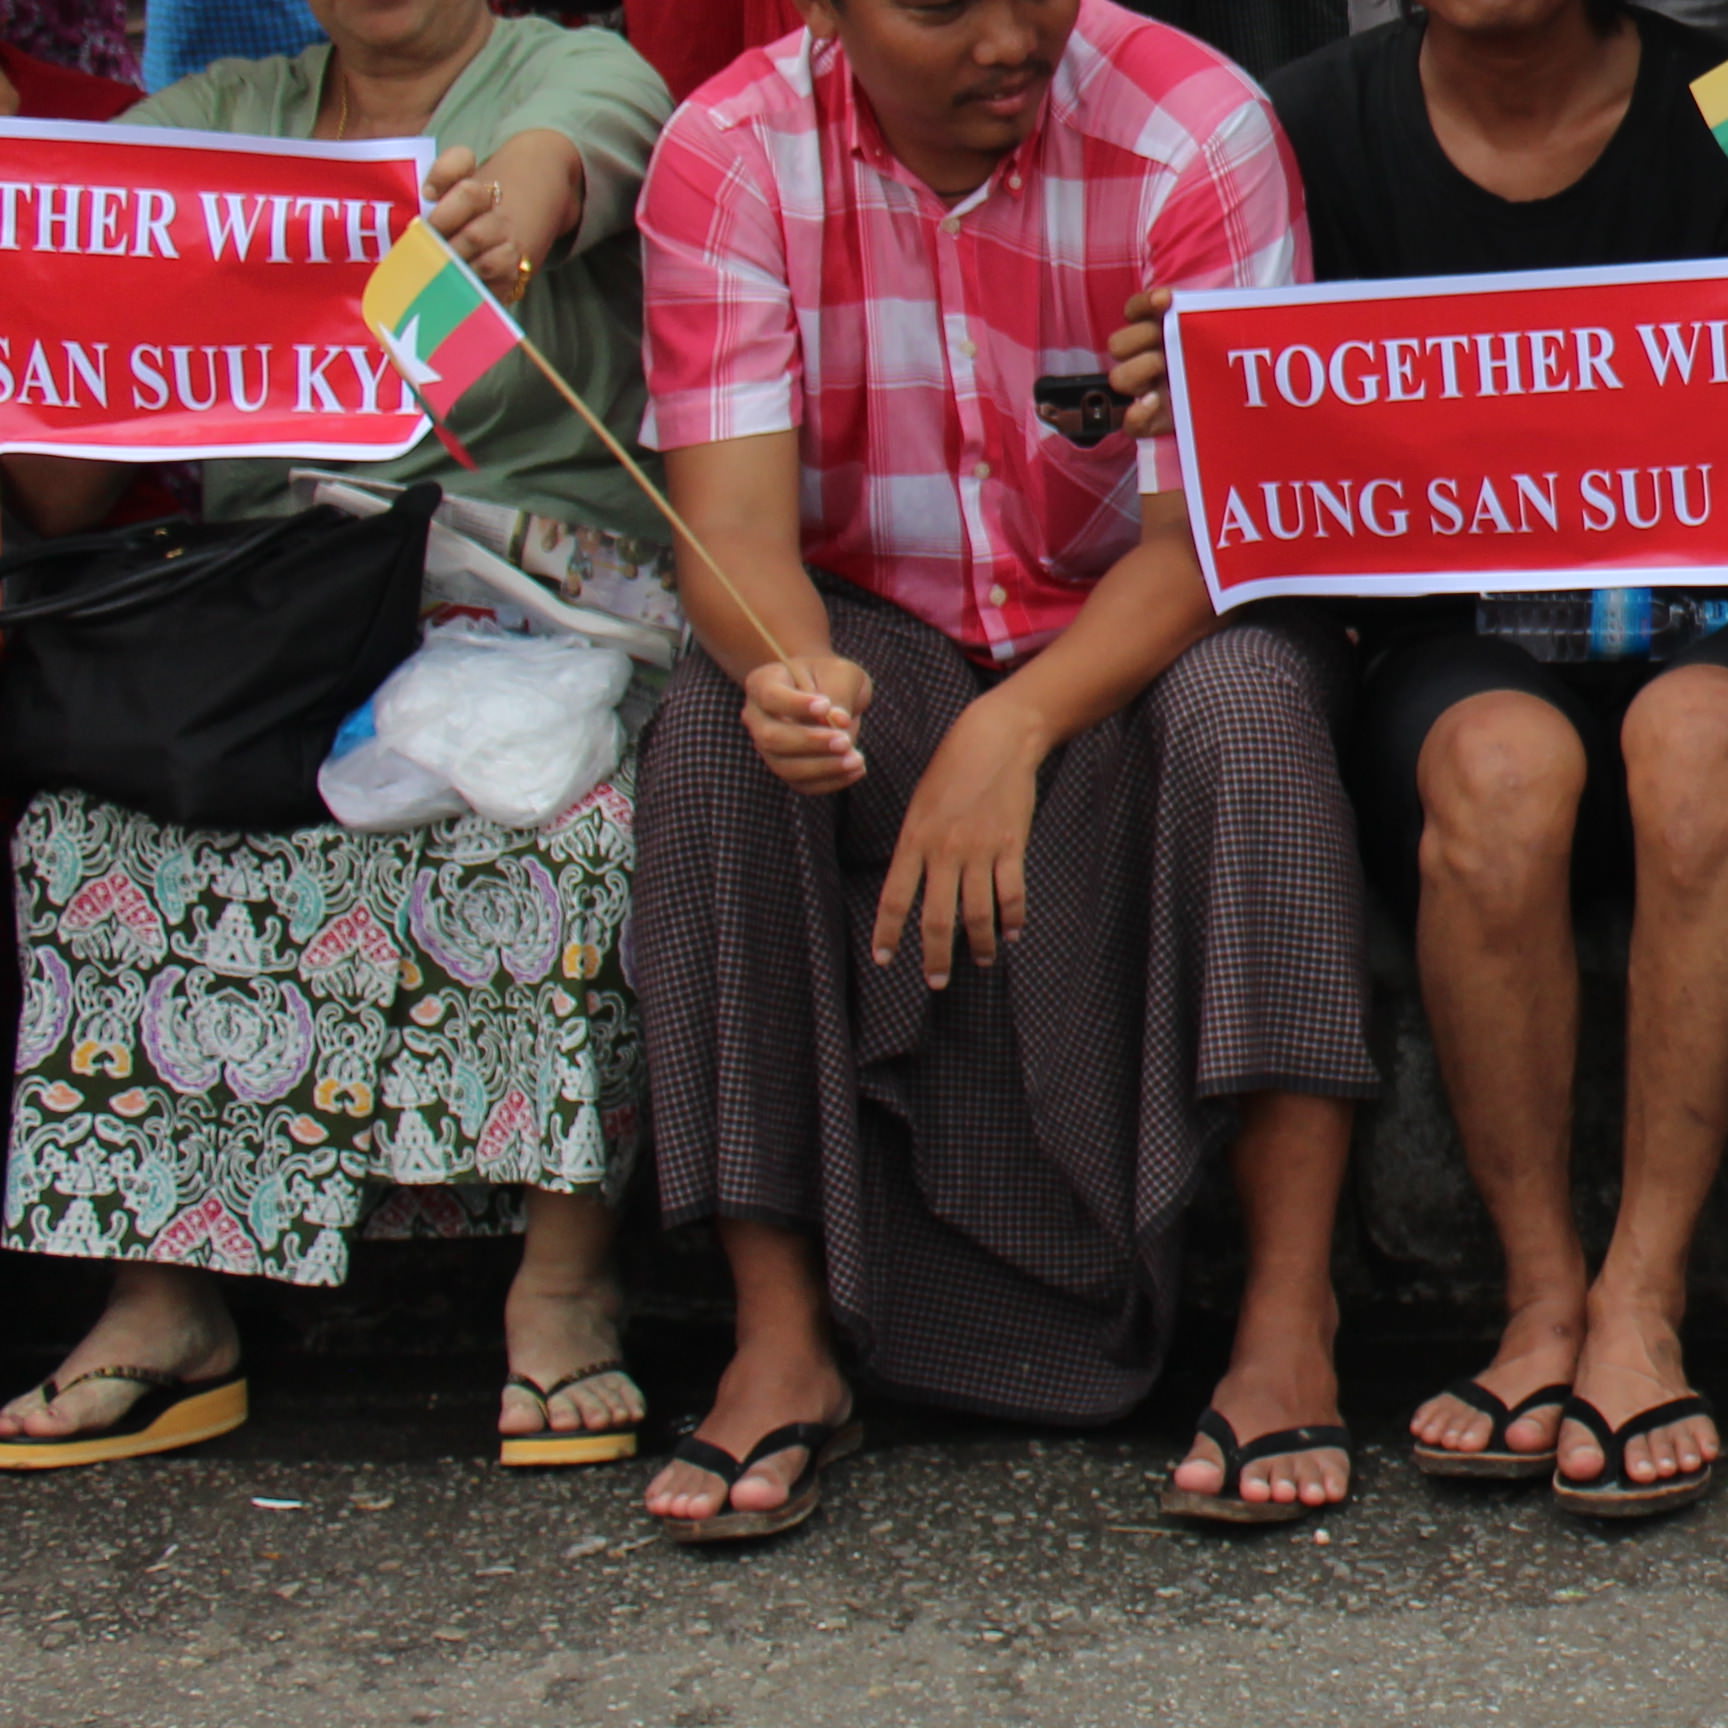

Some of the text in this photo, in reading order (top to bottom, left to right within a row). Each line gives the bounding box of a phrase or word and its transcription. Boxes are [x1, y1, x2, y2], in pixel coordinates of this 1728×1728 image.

[199, 192, 393, 262] WITH
[132, 345, 271, 413] SUU
[1228, 328, 1623, 406] TOGETHER
[1218, 480, 1408, 548] AUNG
[1428, 474, 1557, 534] SAN
[1581, 465, 1711, 530] SUU
